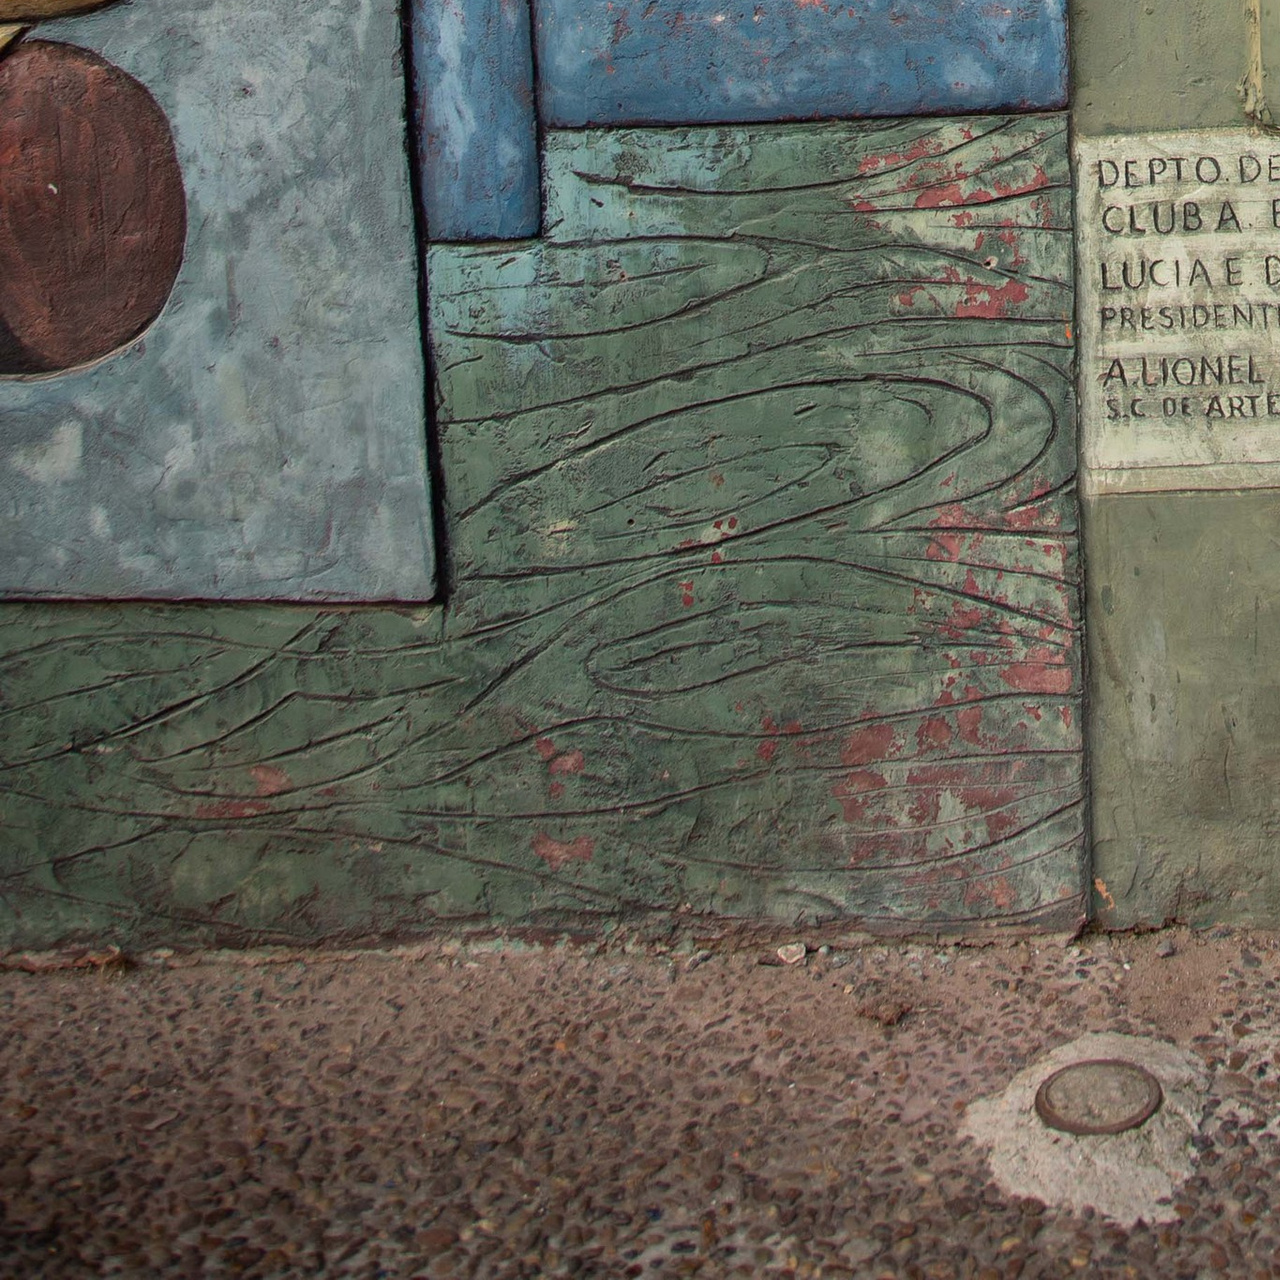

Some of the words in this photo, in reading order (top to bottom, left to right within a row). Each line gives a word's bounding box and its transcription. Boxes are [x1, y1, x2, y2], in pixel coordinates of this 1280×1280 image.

[1097, 155, 1230, 188] DEPTO.
[1101, 200, 1203, 234] CLUB
[1101, 258, 1213, 290] LUCIA
[1161, 396, 1193, 417] DE
